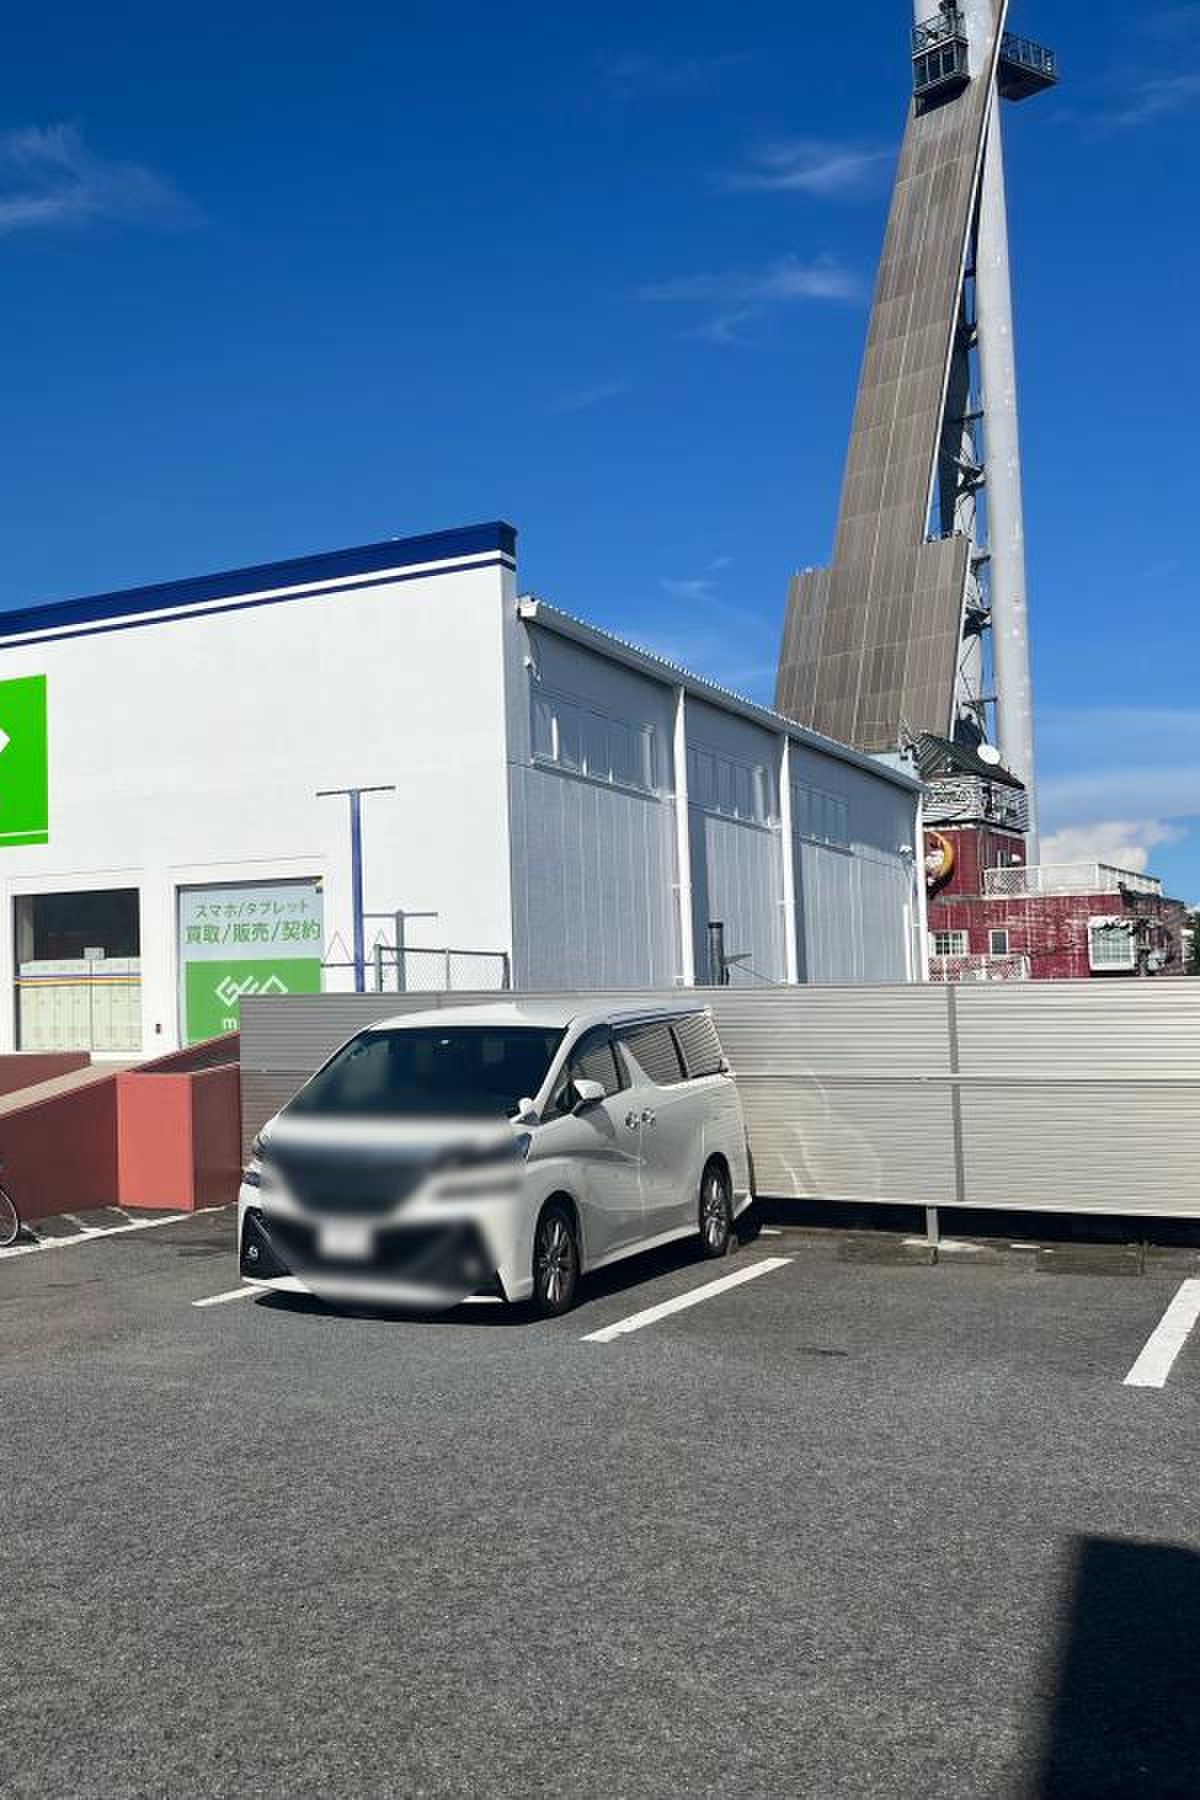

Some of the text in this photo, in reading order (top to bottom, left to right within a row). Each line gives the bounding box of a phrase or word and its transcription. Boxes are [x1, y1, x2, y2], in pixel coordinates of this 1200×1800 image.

[186, 919, 321, 943] 買取/販売/契約
